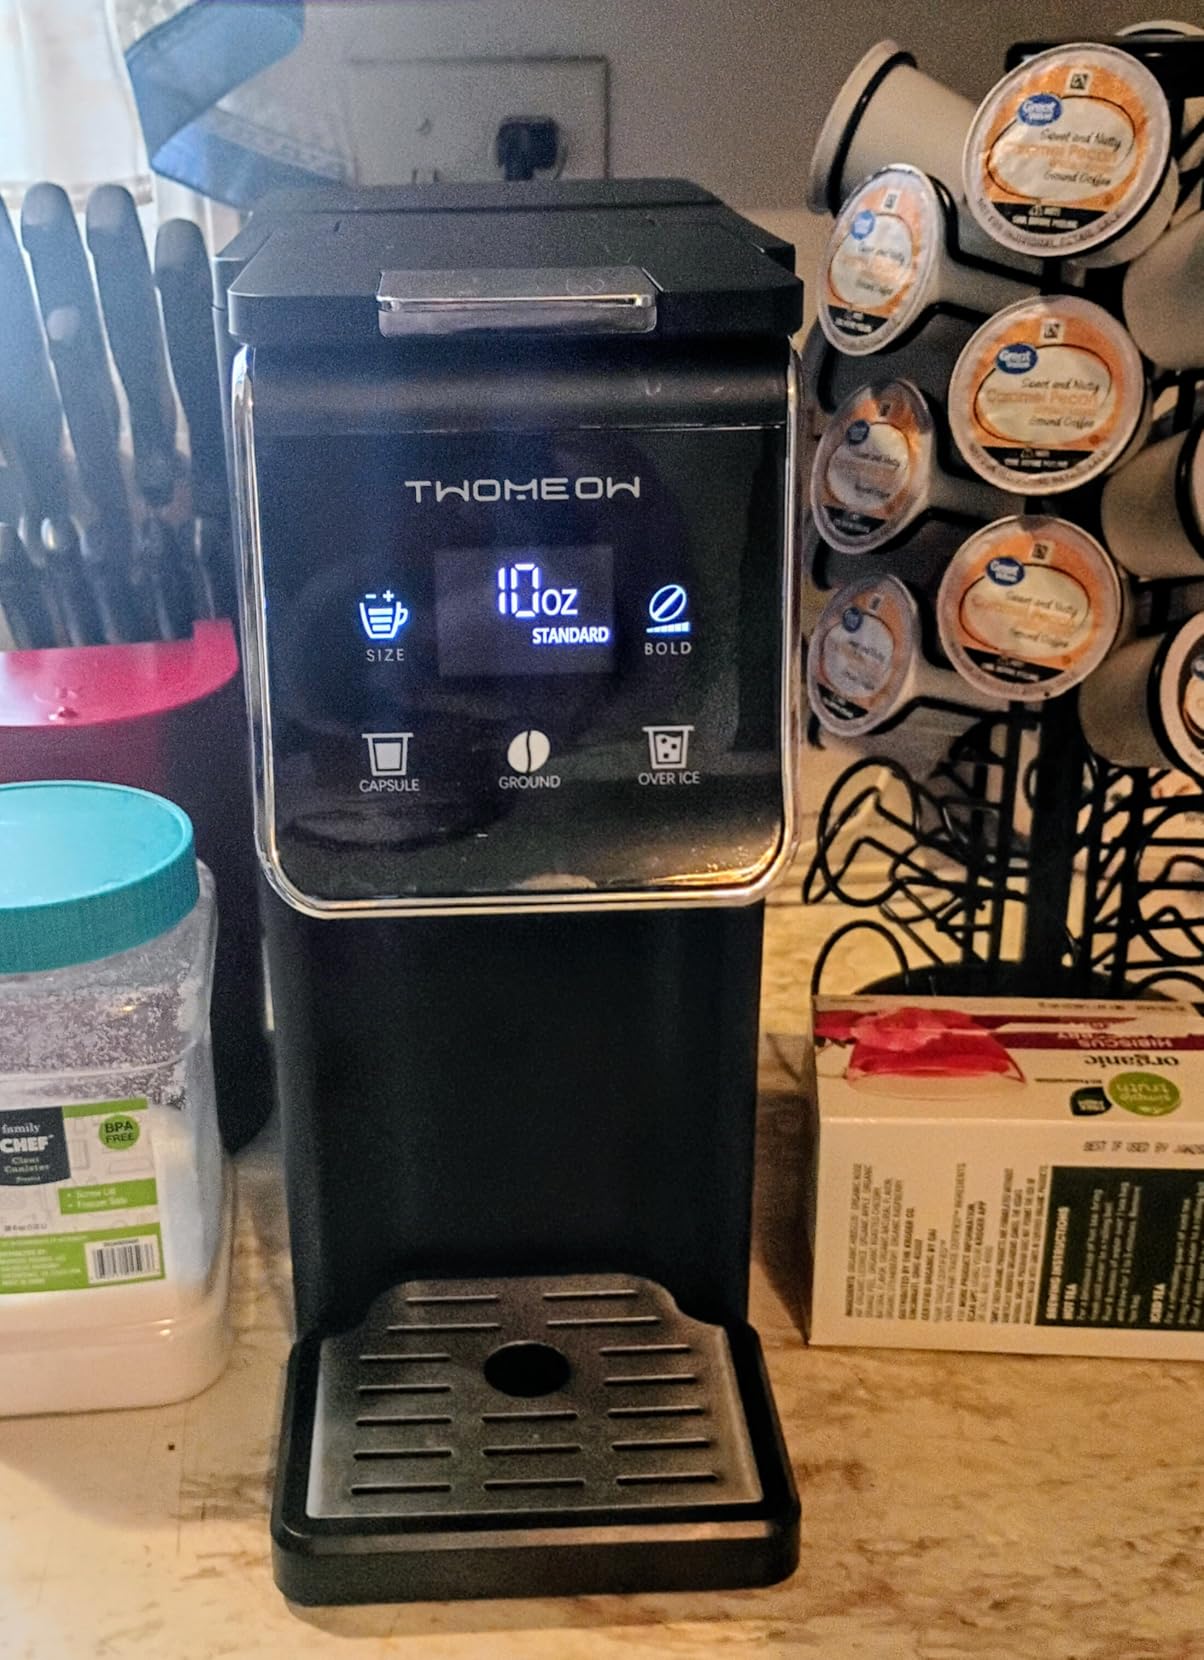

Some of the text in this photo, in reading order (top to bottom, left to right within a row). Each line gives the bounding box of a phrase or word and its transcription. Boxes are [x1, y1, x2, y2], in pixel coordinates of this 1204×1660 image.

[405, 477, 640, 503] TWOMEOW
[532, 626, 609, 645] STANDARD
[366, 649, 405, 662] SIZE
[645, 642, 692, 656] BOLD
[499, 775, 560, 789] GROUND
[638, 771, 700, 786] OVER ICE
[359, 779, 420, 792] CAPSULE
[1079, 1038, 1173, 1048] HIBISCUS
[1084, 1054, 1179, 1068] organic
[2, 1122, 40, 1134] family
[105, 1121, 133, 1133] BPA
[106, 1133, 135, 1143] FREE
